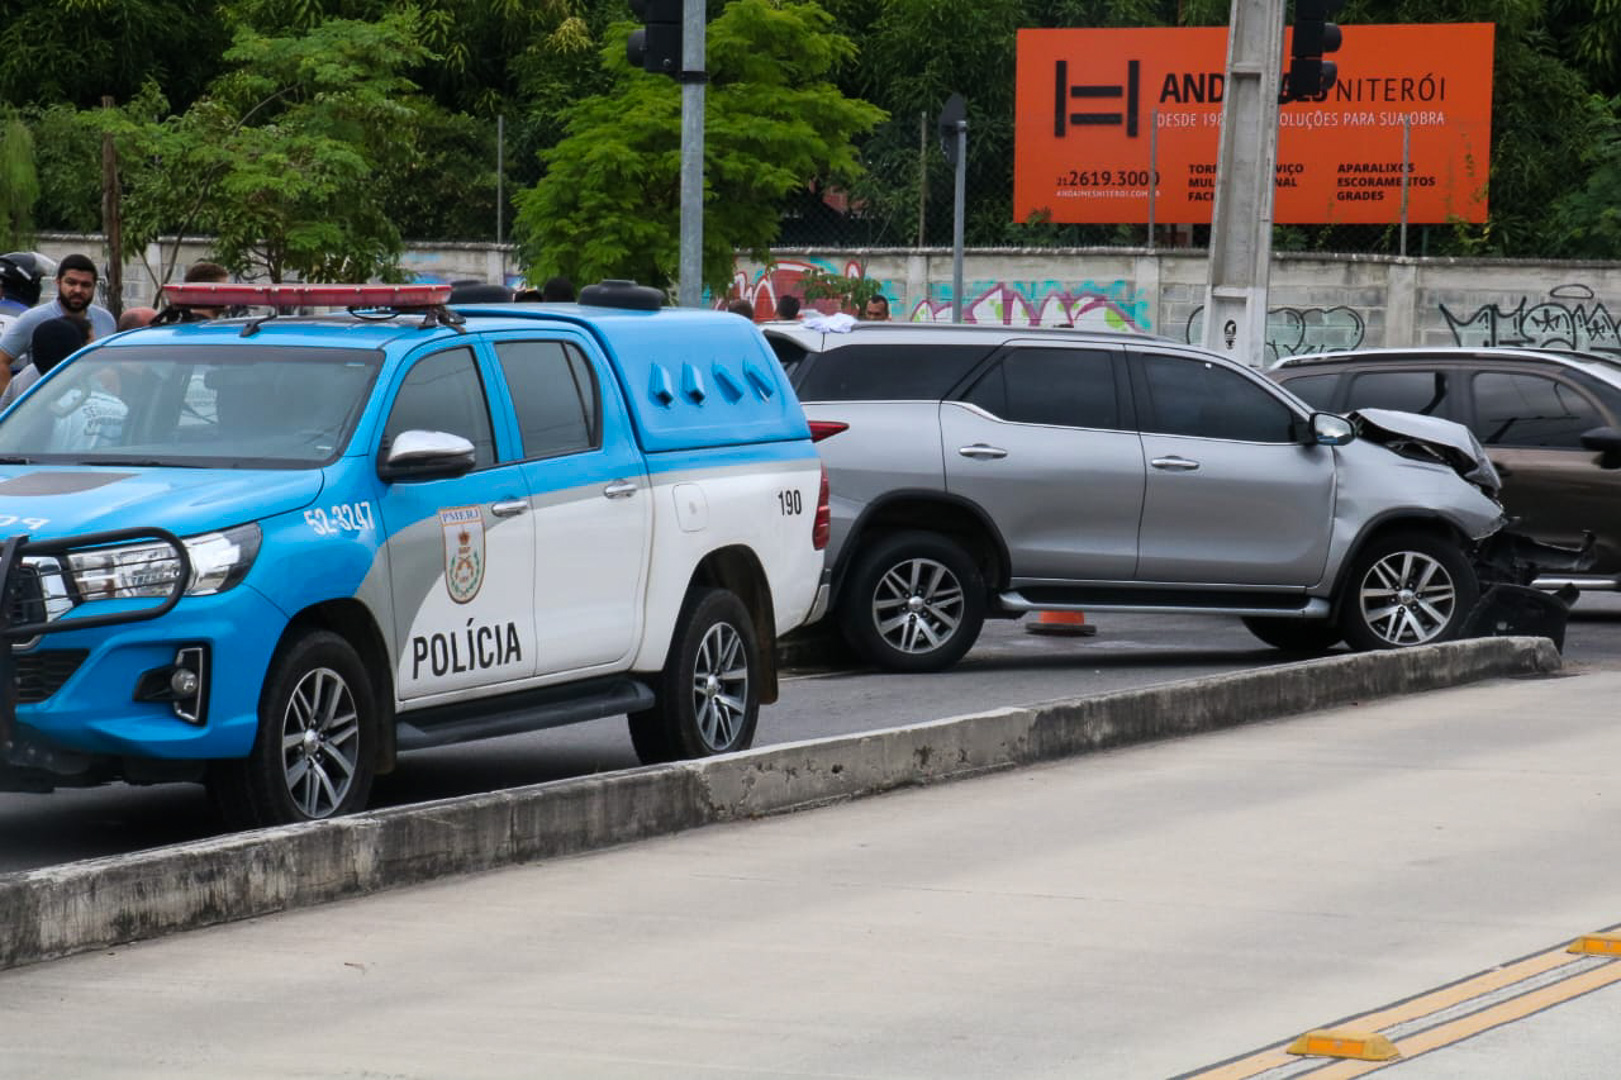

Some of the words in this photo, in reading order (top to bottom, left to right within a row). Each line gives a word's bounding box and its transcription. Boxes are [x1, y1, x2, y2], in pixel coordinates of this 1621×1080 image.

[1159, 72, 1225, 104] AND
[1157, 113, 1197, 128] DESDE
[1279, 109, 1338, 130] OLUÇÕES
[1343, 111, 1375, 127] PARA
[1379, 111, 1404, 127] SUA
[1410, 110, 1445, 126] OBRA
[1275, 164, 1304, 176] VIÇO
[1188, 178, 1216, 188] MUL
[1275, 177, 1298, 188] NAL
[1337, 191, 1384, 201] GRADES
[777, 489, 803, 517] 190
[303, 501, 375, 535] 52-3247
[412, 617, 522, 681] POLÍCIA
